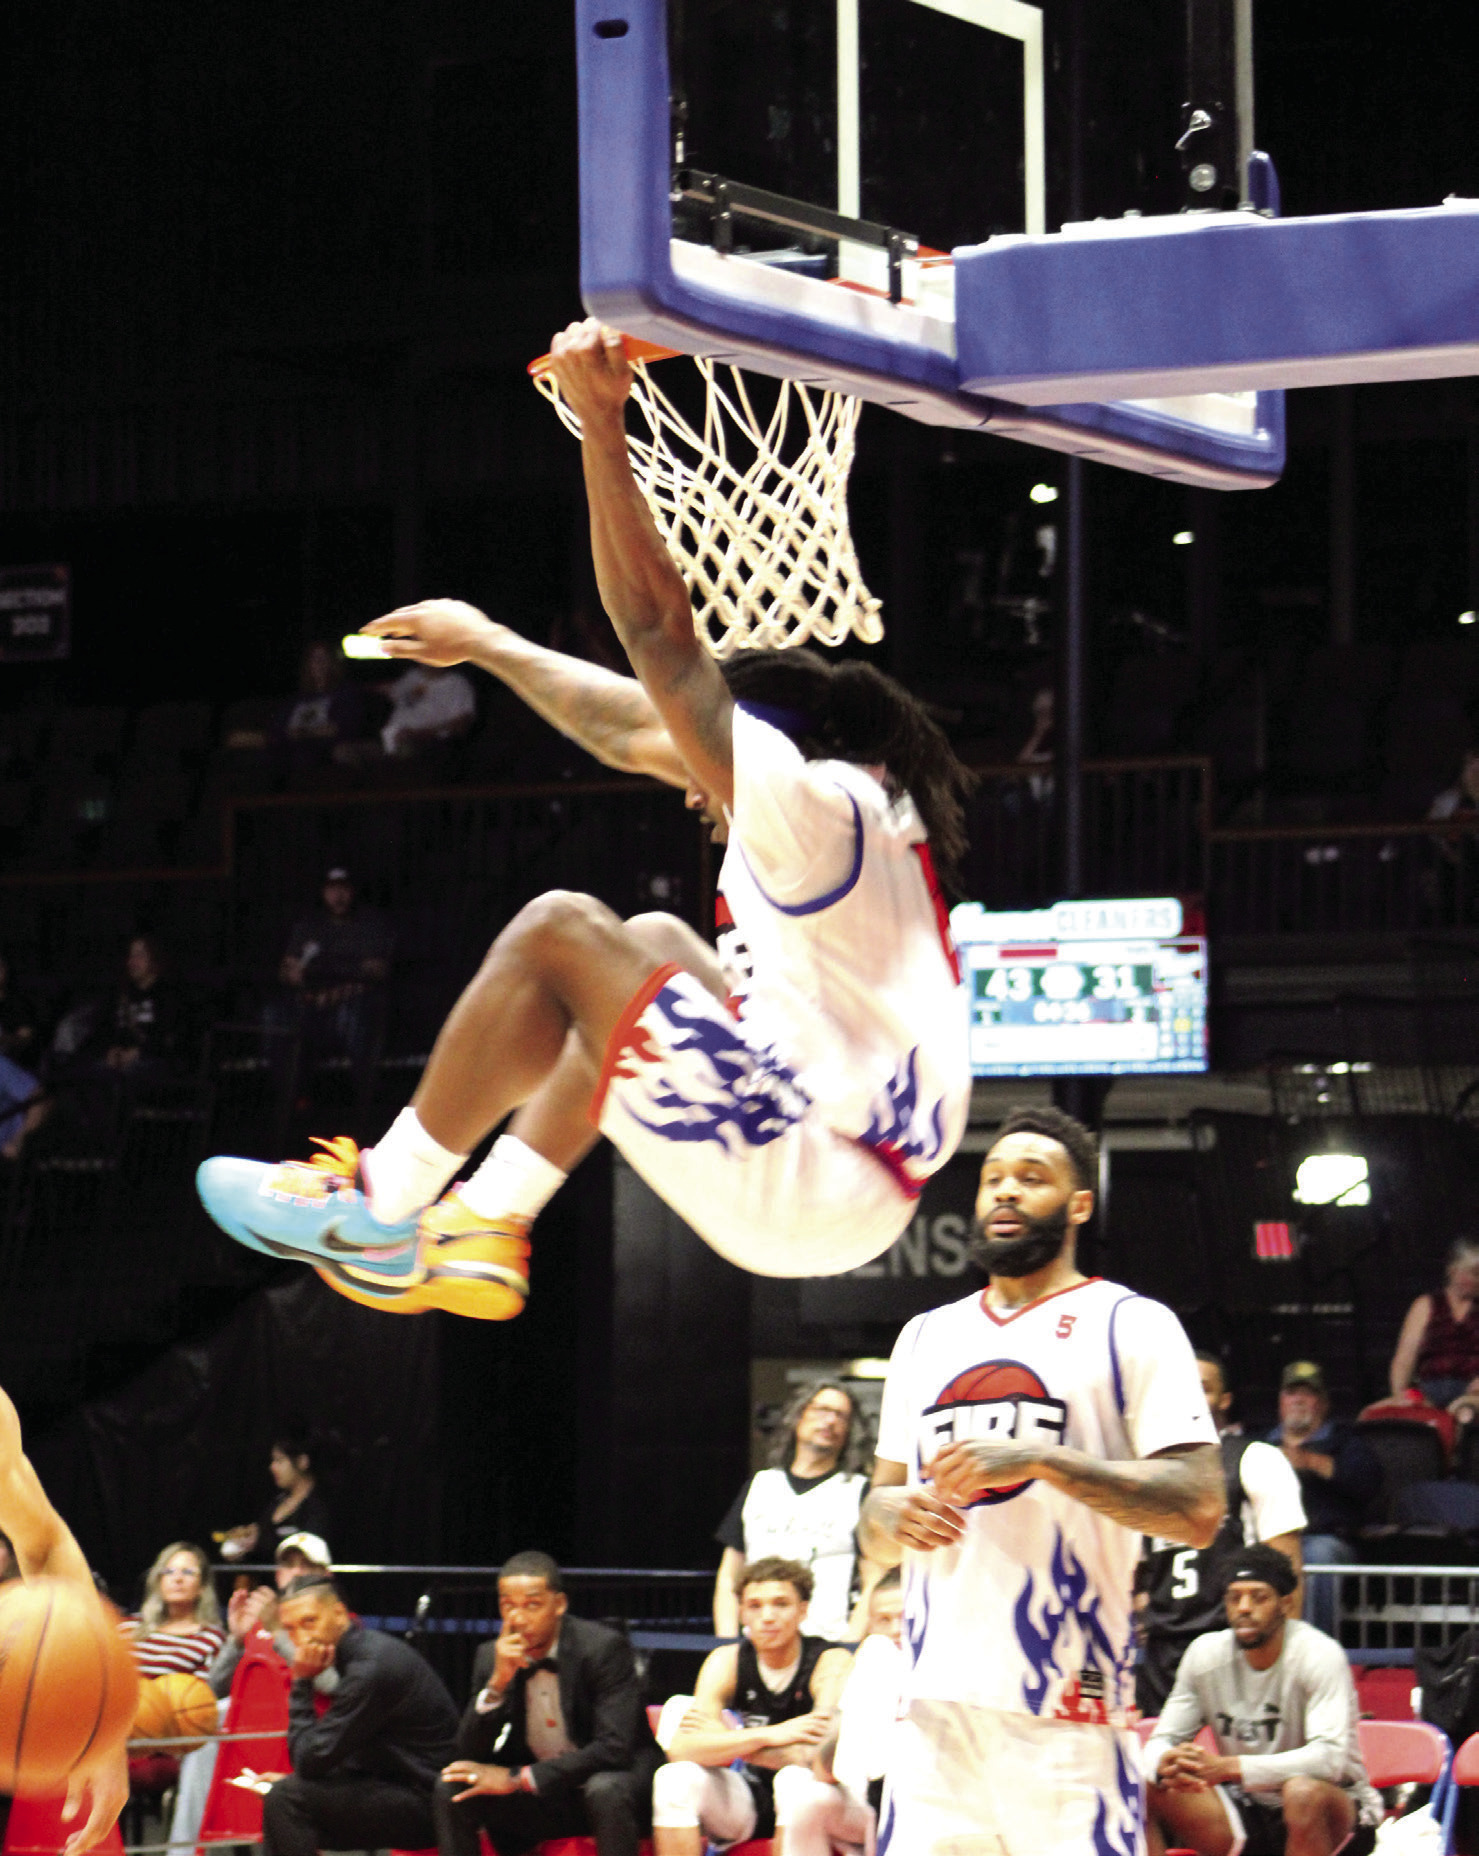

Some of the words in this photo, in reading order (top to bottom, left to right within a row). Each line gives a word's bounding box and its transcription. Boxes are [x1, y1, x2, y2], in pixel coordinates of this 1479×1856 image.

[985, 966, 1034, 1002] 43
[1092, 964, 1140, 1000] 31
[1055, 1314, 1078, 1340] 5
[1171, 1549, 1200, 1600] 5
